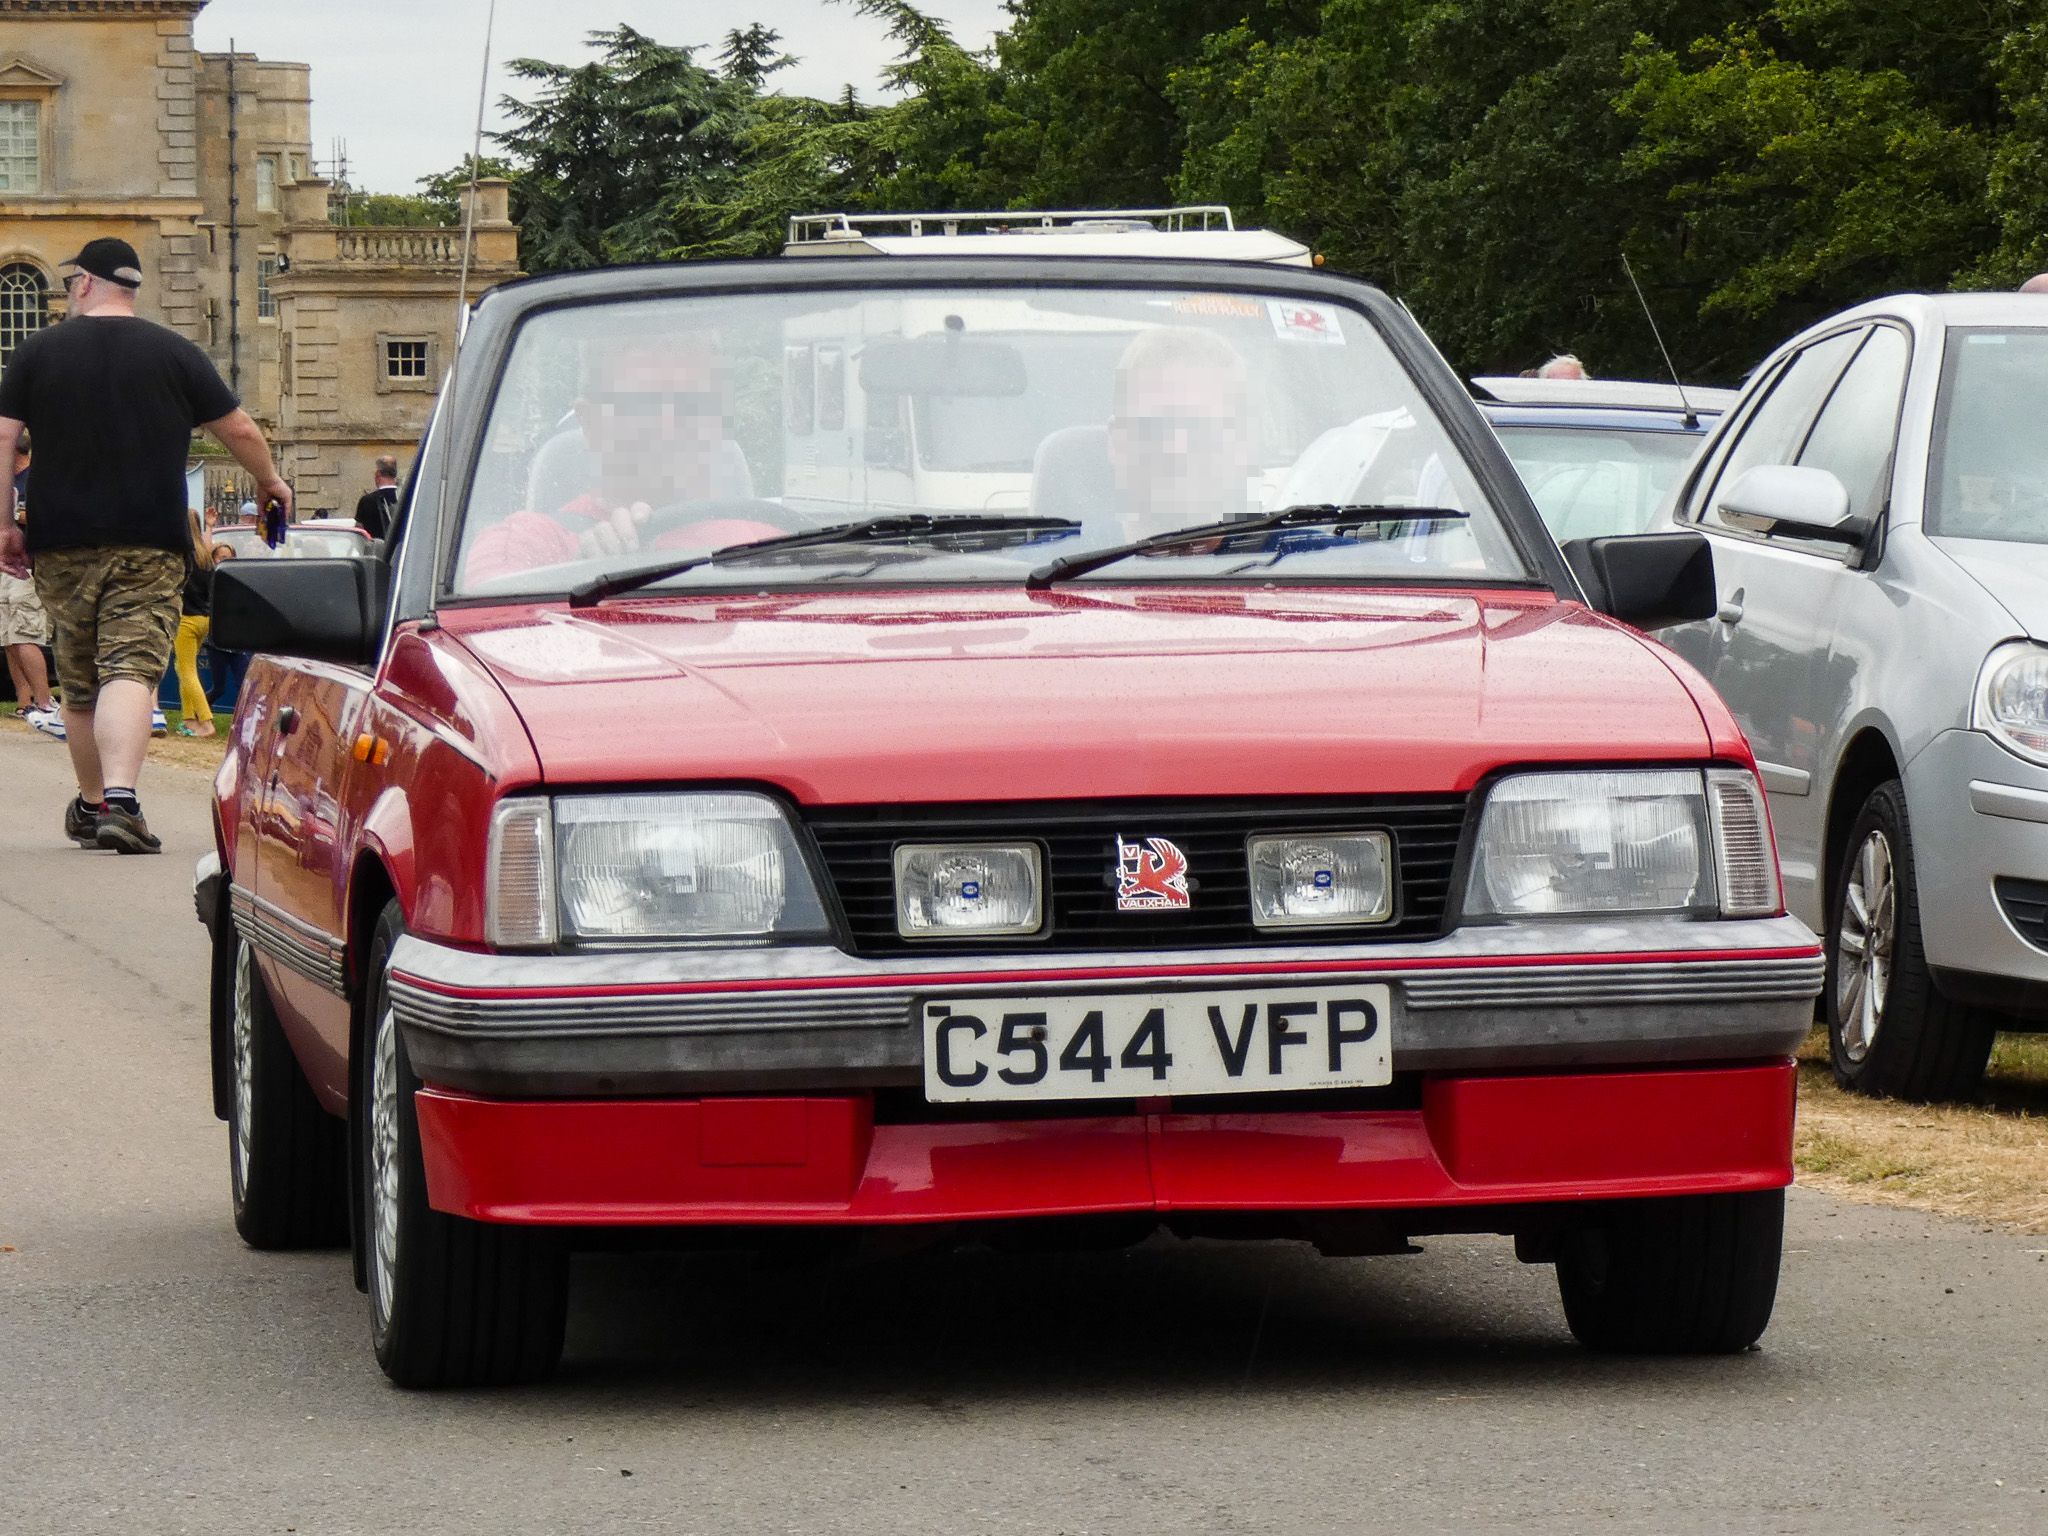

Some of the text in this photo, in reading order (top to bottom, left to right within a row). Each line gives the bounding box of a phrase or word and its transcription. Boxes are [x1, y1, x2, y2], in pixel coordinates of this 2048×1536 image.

[1124, 847, 1136, 857] V
[1121, 898, 1187, 908] VAUXHALL
[935, 998, 1378, 1087] C544 VFP
